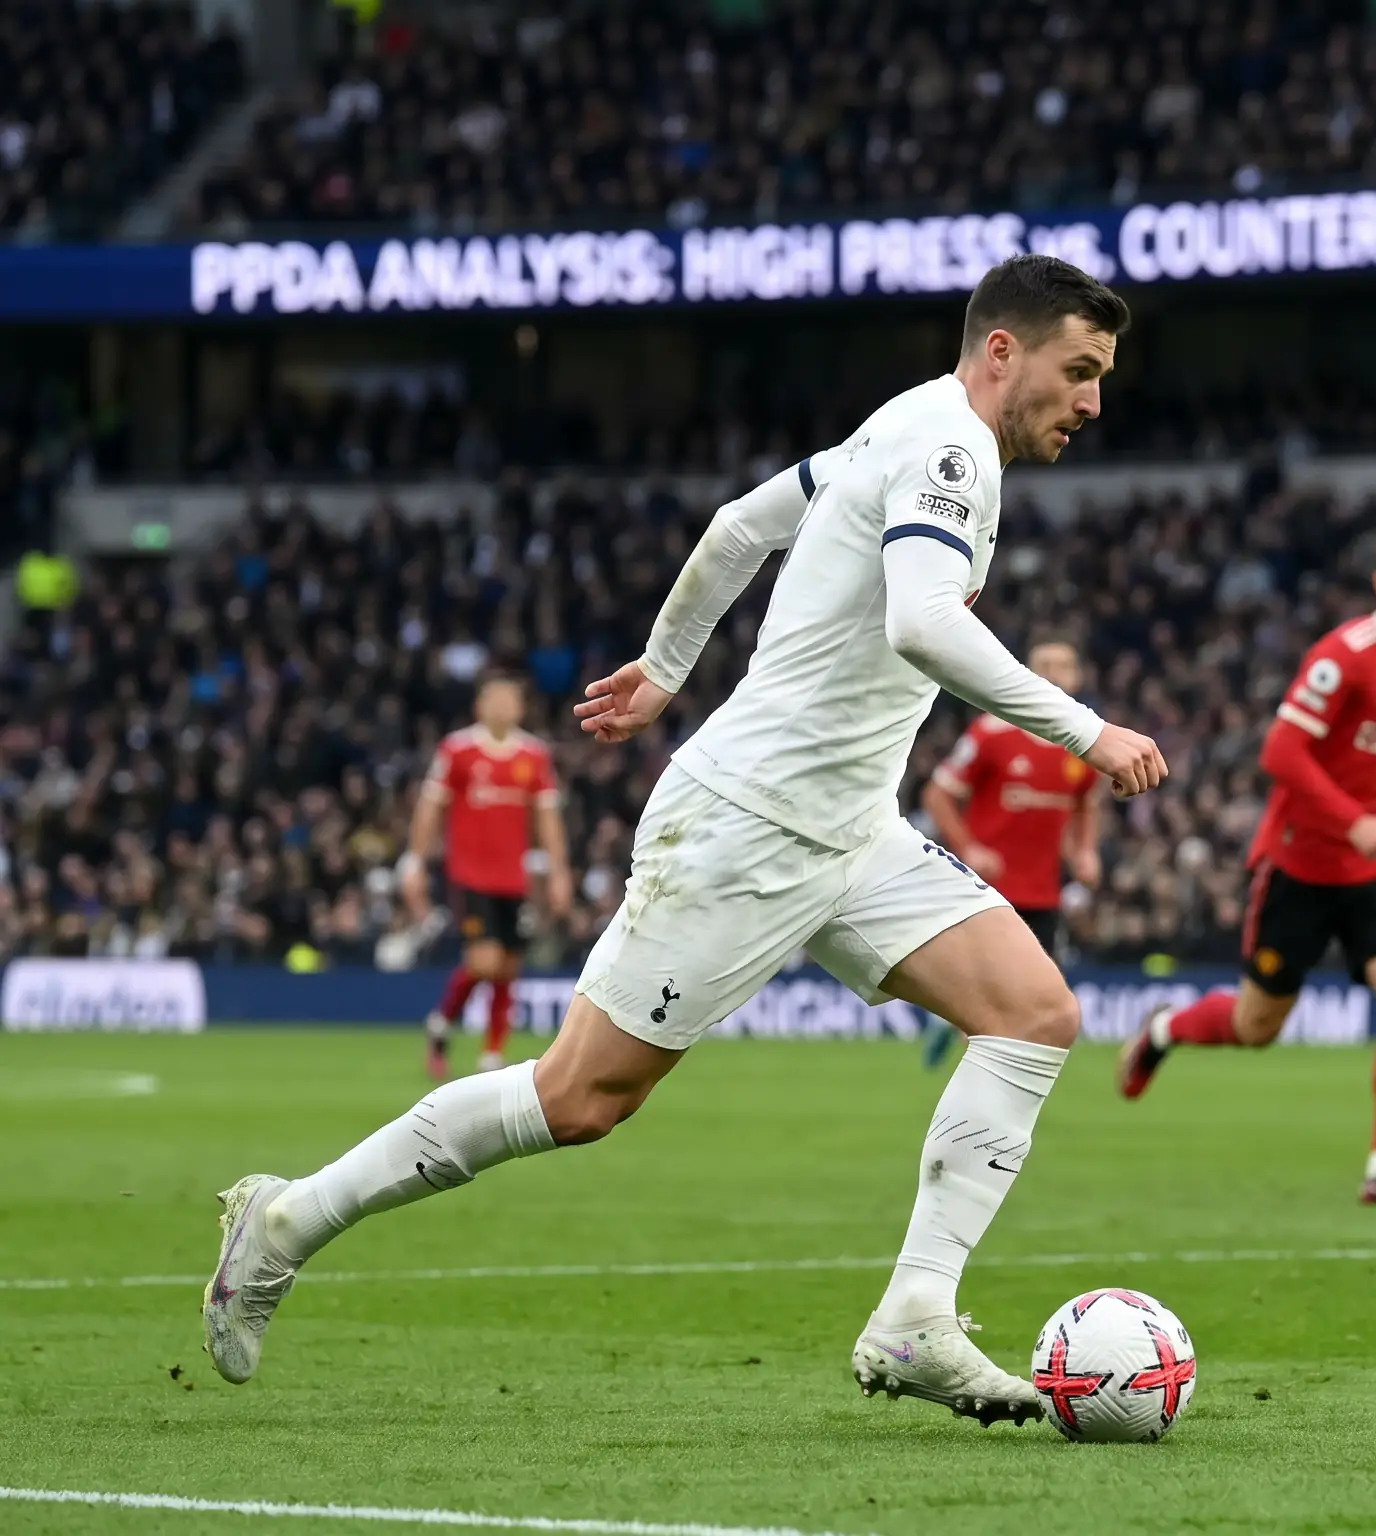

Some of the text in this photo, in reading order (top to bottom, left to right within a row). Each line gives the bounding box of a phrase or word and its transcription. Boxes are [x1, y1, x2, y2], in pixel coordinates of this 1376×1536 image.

[191, 241, 364, 313] PPDA
[368, 231, 675, 309] ANALYSIS:
[682, 224, 834, 300] HIGH
[840, 214, 1026, 295] PRESS
